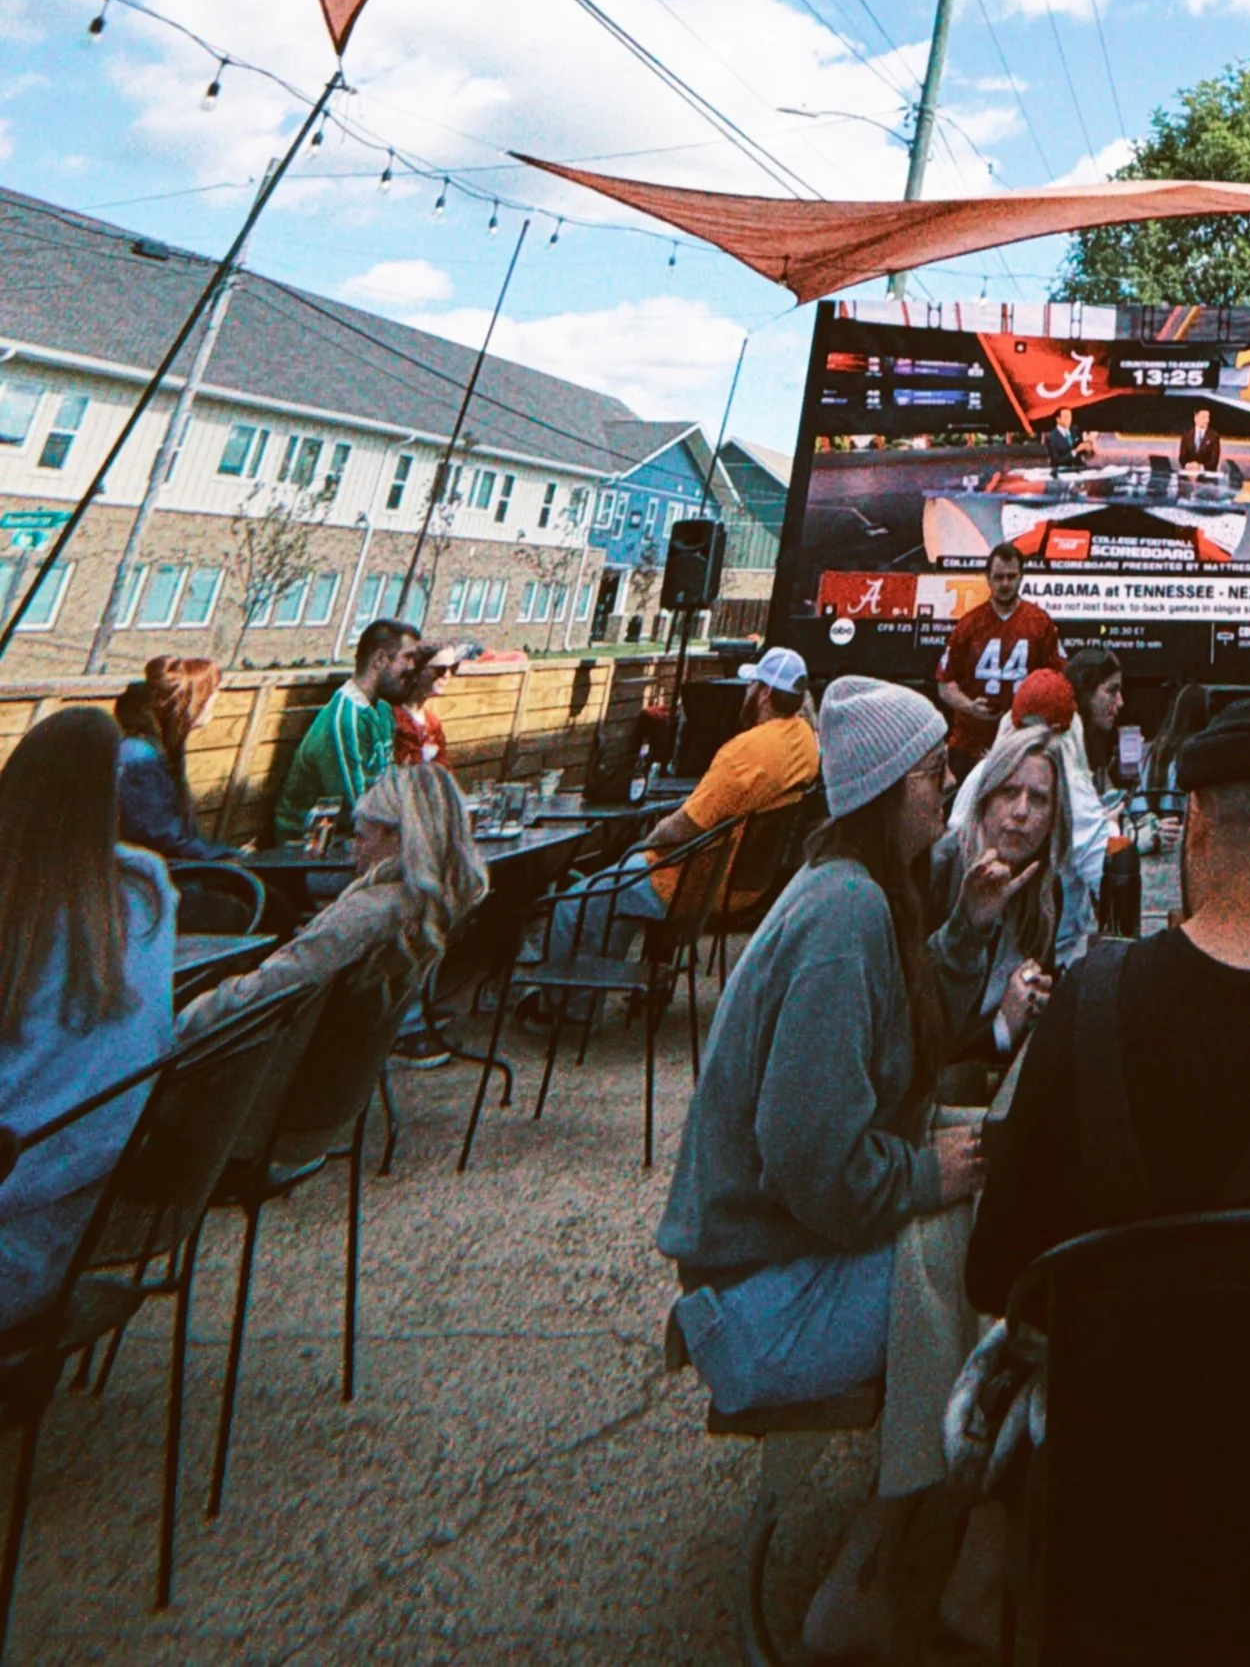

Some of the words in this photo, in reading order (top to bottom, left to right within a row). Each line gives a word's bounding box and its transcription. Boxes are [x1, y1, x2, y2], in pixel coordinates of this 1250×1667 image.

[1133, 368, 1204, 386] 13:25
[1092, 535, 1138, 545] COLLEGE
[1139, 537, 1194, 547] FOOTBALL
[1091, 544, 1195, 560] SCOREBOARD
[1050, 560, 1119, 570] SCOREBOARD
[1122, 561, 1182, 570] PRESENTED
[1186, 562, 1199, 571] BY
[1022, 582, 1100, 596] ALABAMA
[1105, 585, 1119, 597] at
[1124, 584, 1214, 599] TENNESSEE
[1045, 601, 1062, 611] has
[1064, 602, 1081, 611] not
[1082, 601, 1100, 611] lost
[1168, 604, 1200, 615] games
[1213, 604, 1241, 615] single
[974, 637, 1029, 695] 44
